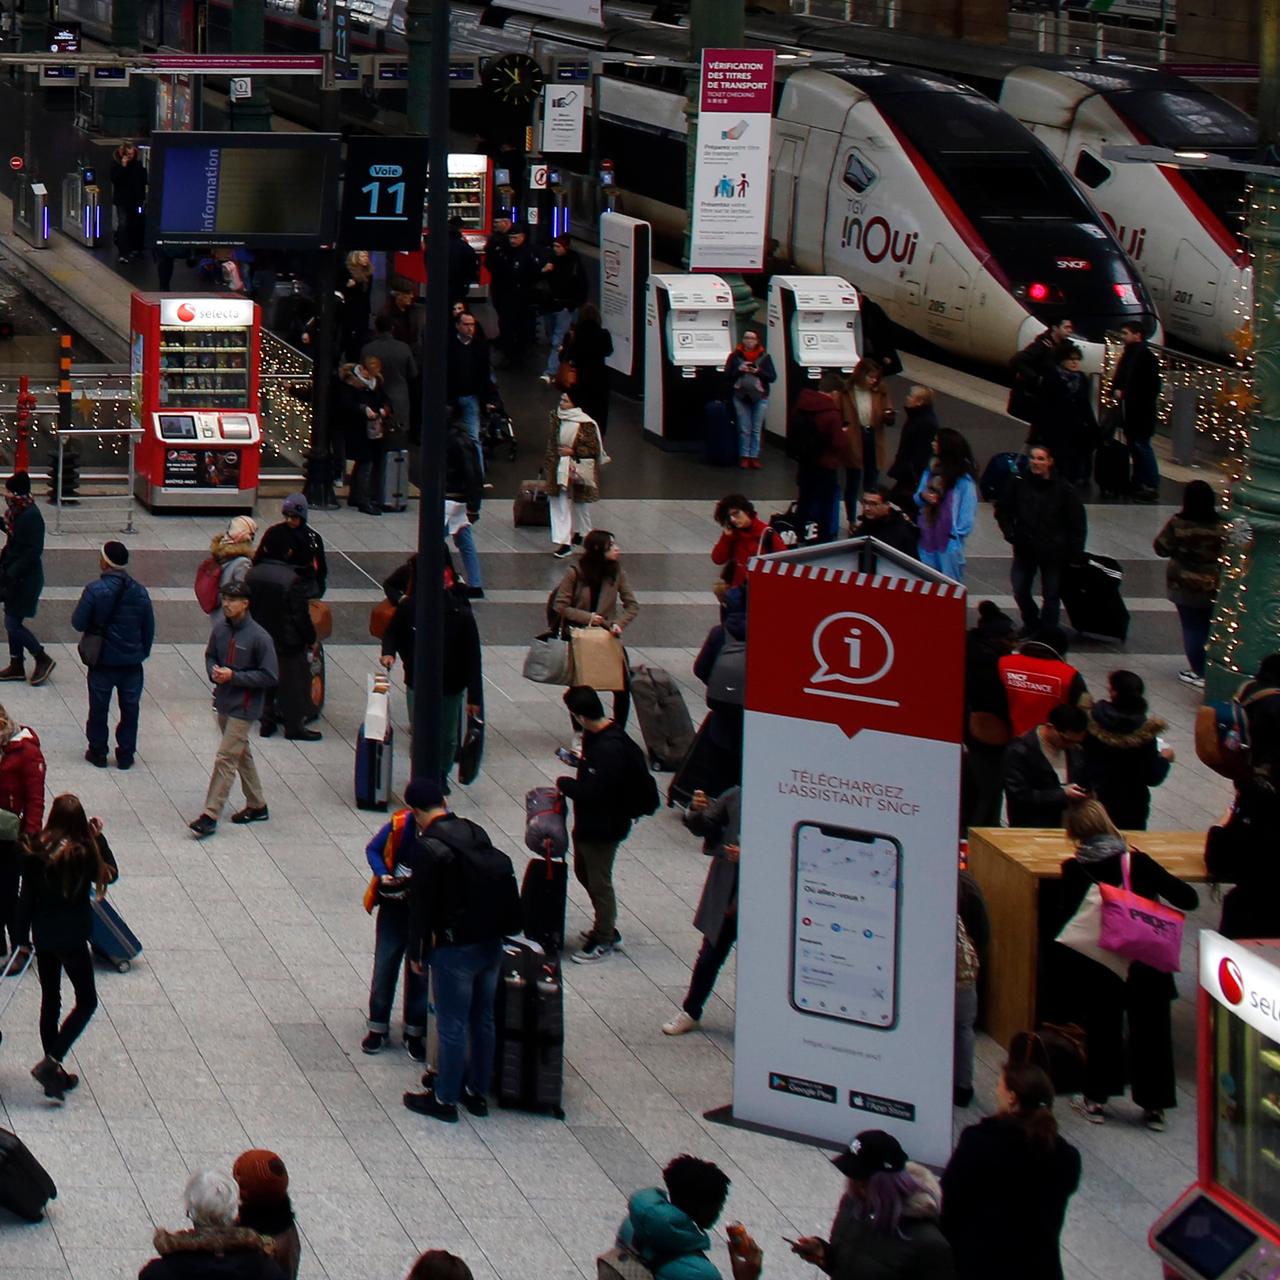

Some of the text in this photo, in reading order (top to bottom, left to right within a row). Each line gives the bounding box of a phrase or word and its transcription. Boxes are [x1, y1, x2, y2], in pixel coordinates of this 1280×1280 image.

[708, 62, 764, 70] VÉRIFICATION
[707, 72, 752, 80] DES TITRES
[720, 82, 768, 90] TRANSPORT
[373, 166, 398, 176] Voie
[201, 148, 220, 232] information
[361, 181, 407, 215] 11
[847, 198, 868, 215] TGV
[1056, 260, 1088, 269] SNCF
[1174, 290, 1193, 304] 201
[200, 308, 240, 319] selecta
[928, 300, 945, 314] 205
[1006, 672, 1028, 682] SNCF
[1007, 679, 1054, 694] ASSISTANCE
[791, 768, 904, 800] TÉLÉCHARGEZ
[778, 782, 920, 817] L'ASSISTANT SNCF
